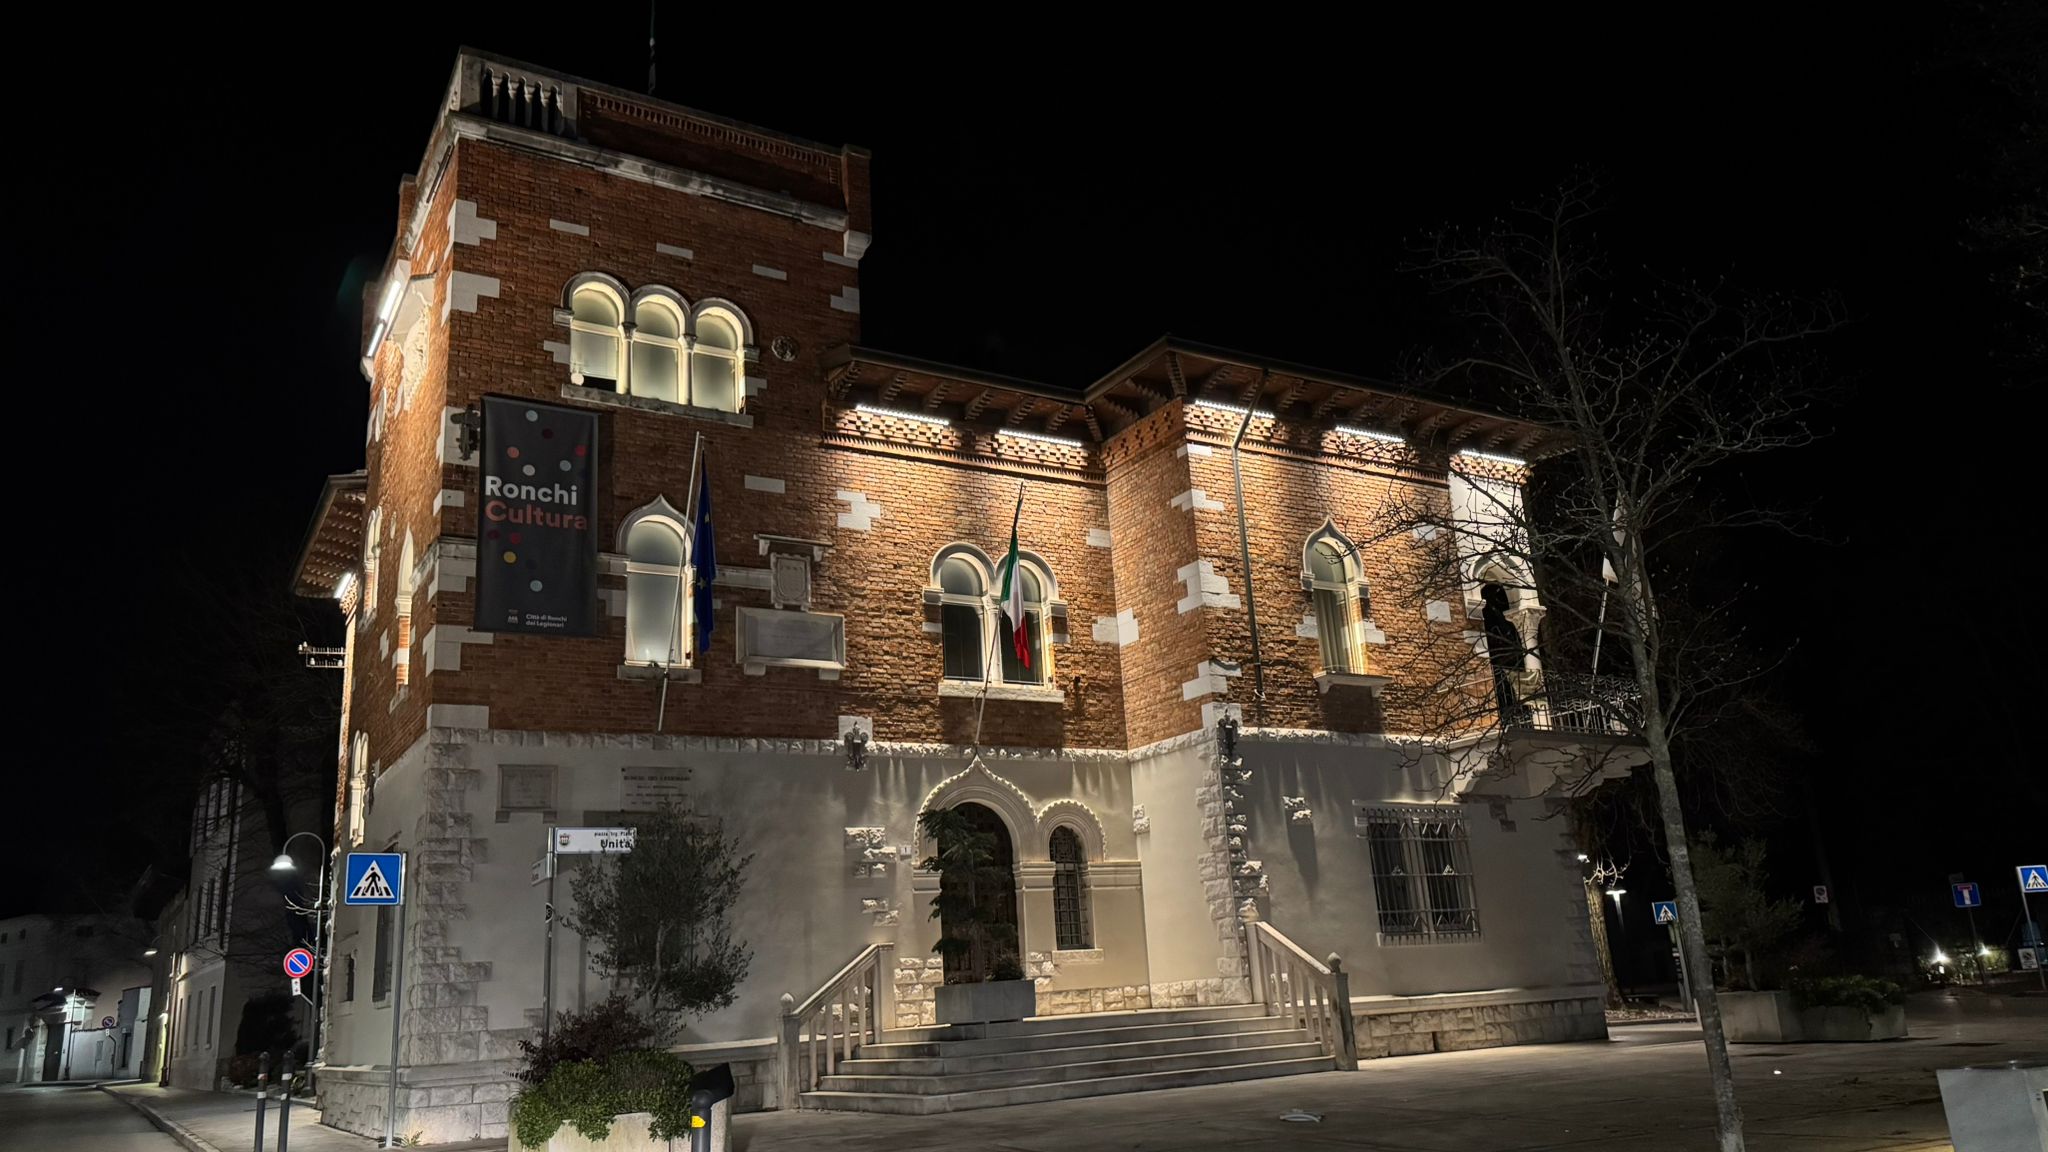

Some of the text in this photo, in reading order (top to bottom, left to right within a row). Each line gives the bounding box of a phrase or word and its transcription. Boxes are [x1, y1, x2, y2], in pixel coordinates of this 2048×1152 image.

[485, 475, 577, 505] Ronchi
[485, 500, 587, 529] Cultura
[536, 620, 564, 629] Legionari
